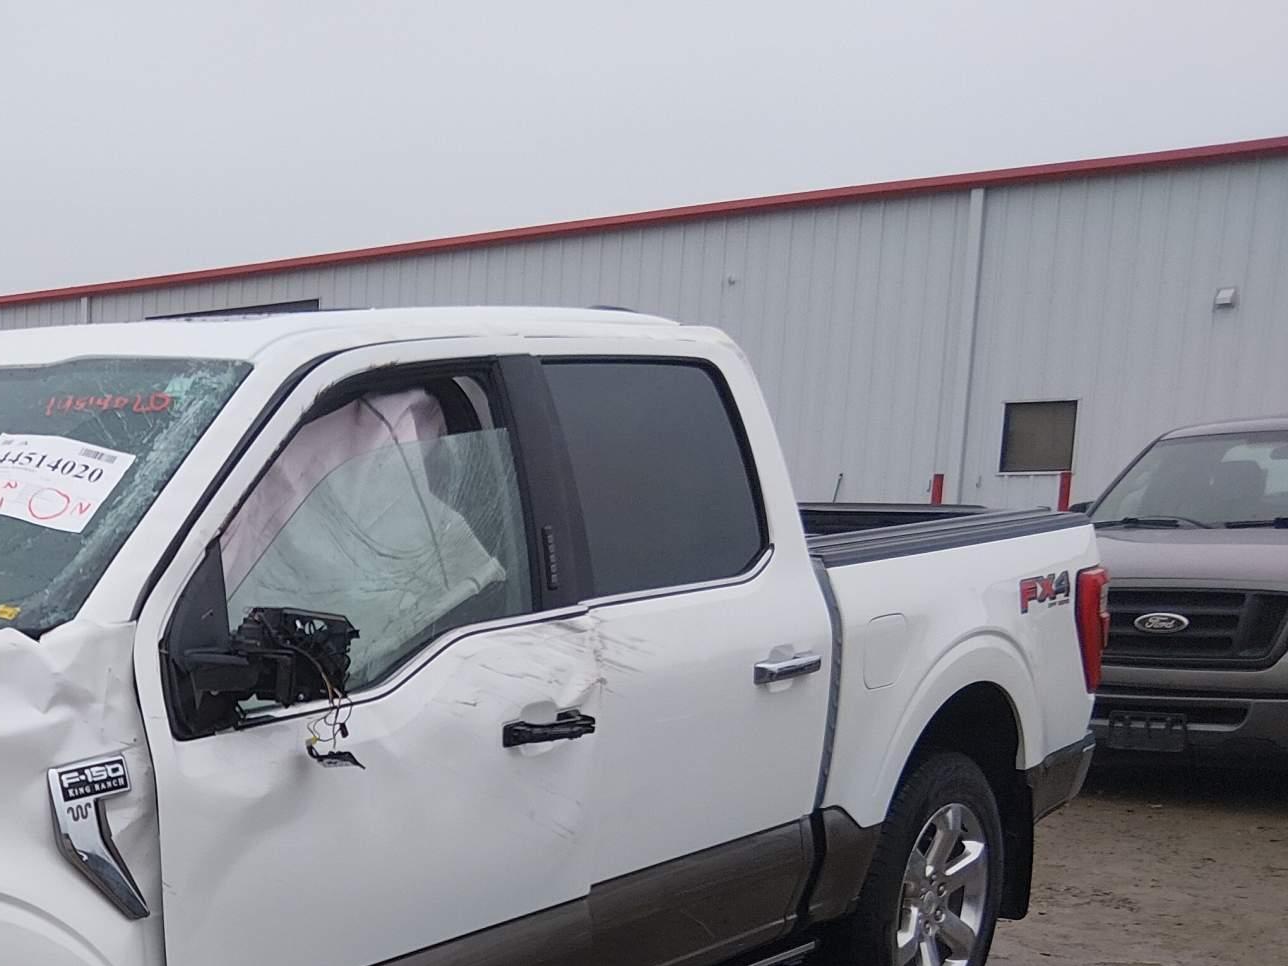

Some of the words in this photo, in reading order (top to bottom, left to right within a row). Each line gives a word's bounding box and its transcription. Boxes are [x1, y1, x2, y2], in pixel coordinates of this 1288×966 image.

[1020, 570, 1070, 614] FX4
[1144, 616, 1176, 629] Ford
[61, 763, 125, 788] F-150
[68, 785, 91, 797] KING
[94, 777, 125, 792] RANCH
